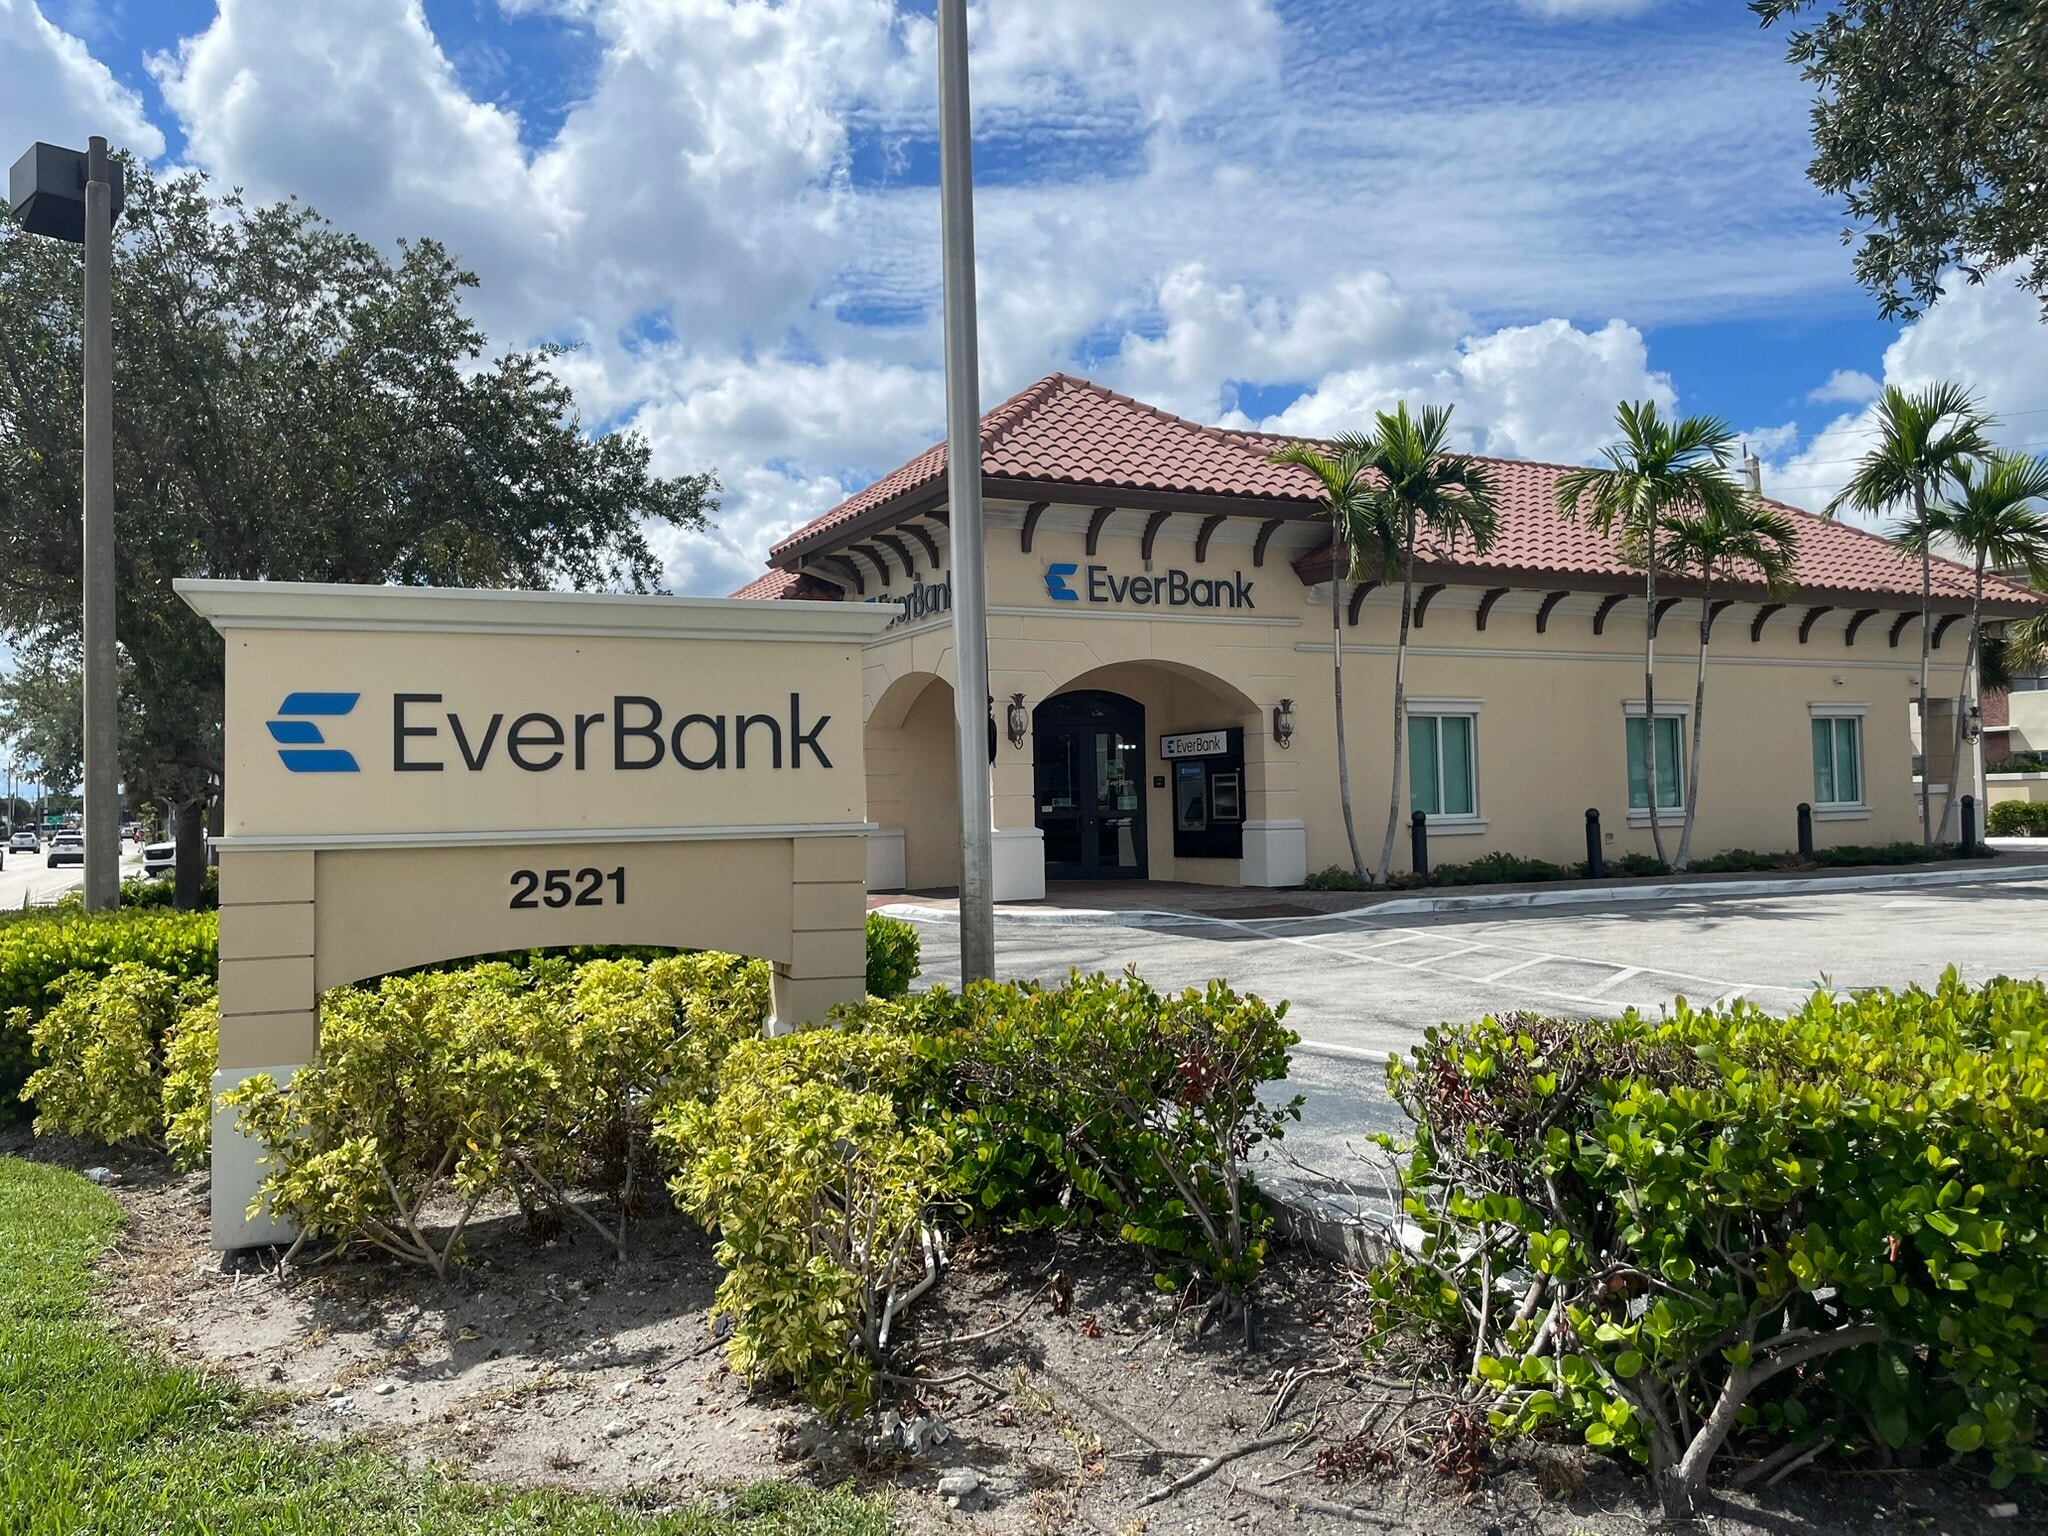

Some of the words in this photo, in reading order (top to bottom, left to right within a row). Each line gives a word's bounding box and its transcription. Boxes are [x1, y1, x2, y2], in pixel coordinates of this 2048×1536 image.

[1088, 566, 1255, 608] EverBank
[393, 692, 834, 772] EverBank
[1177, 736, 1221, 754] EverBank
[509, 866, 626, 909] 2521
